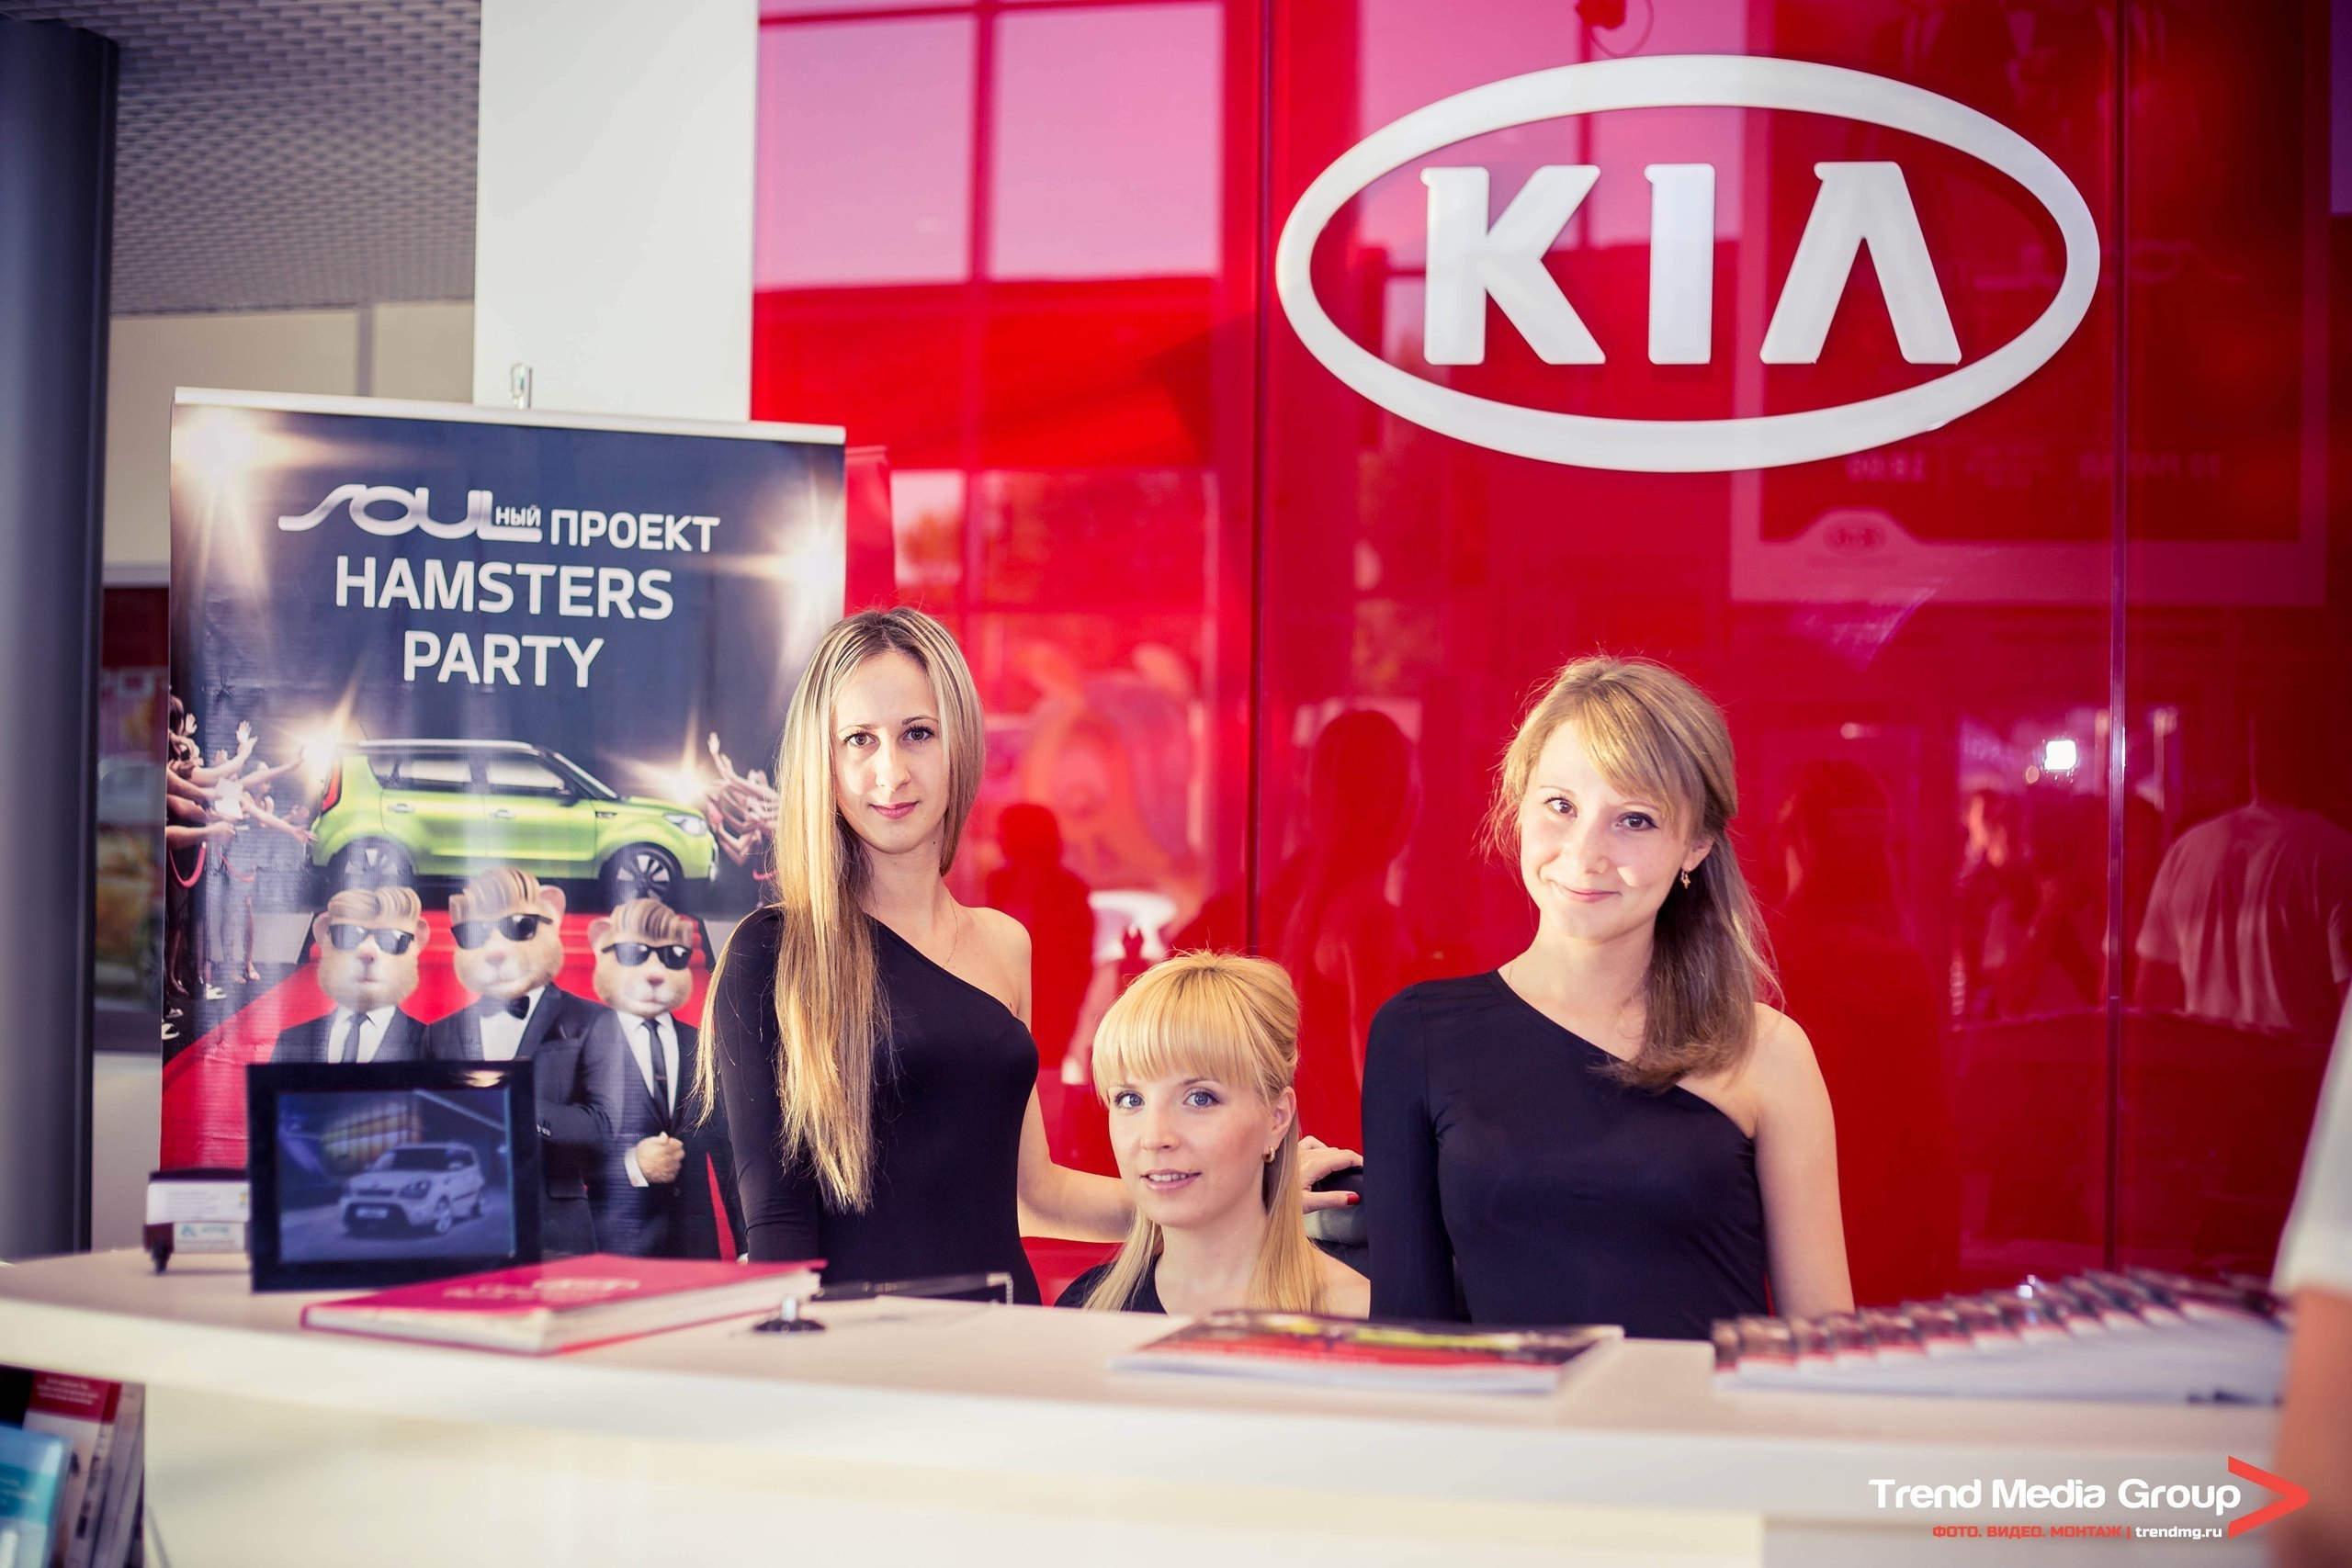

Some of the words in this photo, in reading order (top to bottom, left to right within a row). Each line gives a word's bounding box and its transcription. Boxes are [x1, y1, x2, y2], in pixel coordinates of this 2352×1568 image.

[1420, 161, 1963, 366] KIA
[550, 508, 721, 553] ПРОЕКТ
[334, 555, 674, 621] HAMSTERS
[403, 630, 605, 689] PARTY
